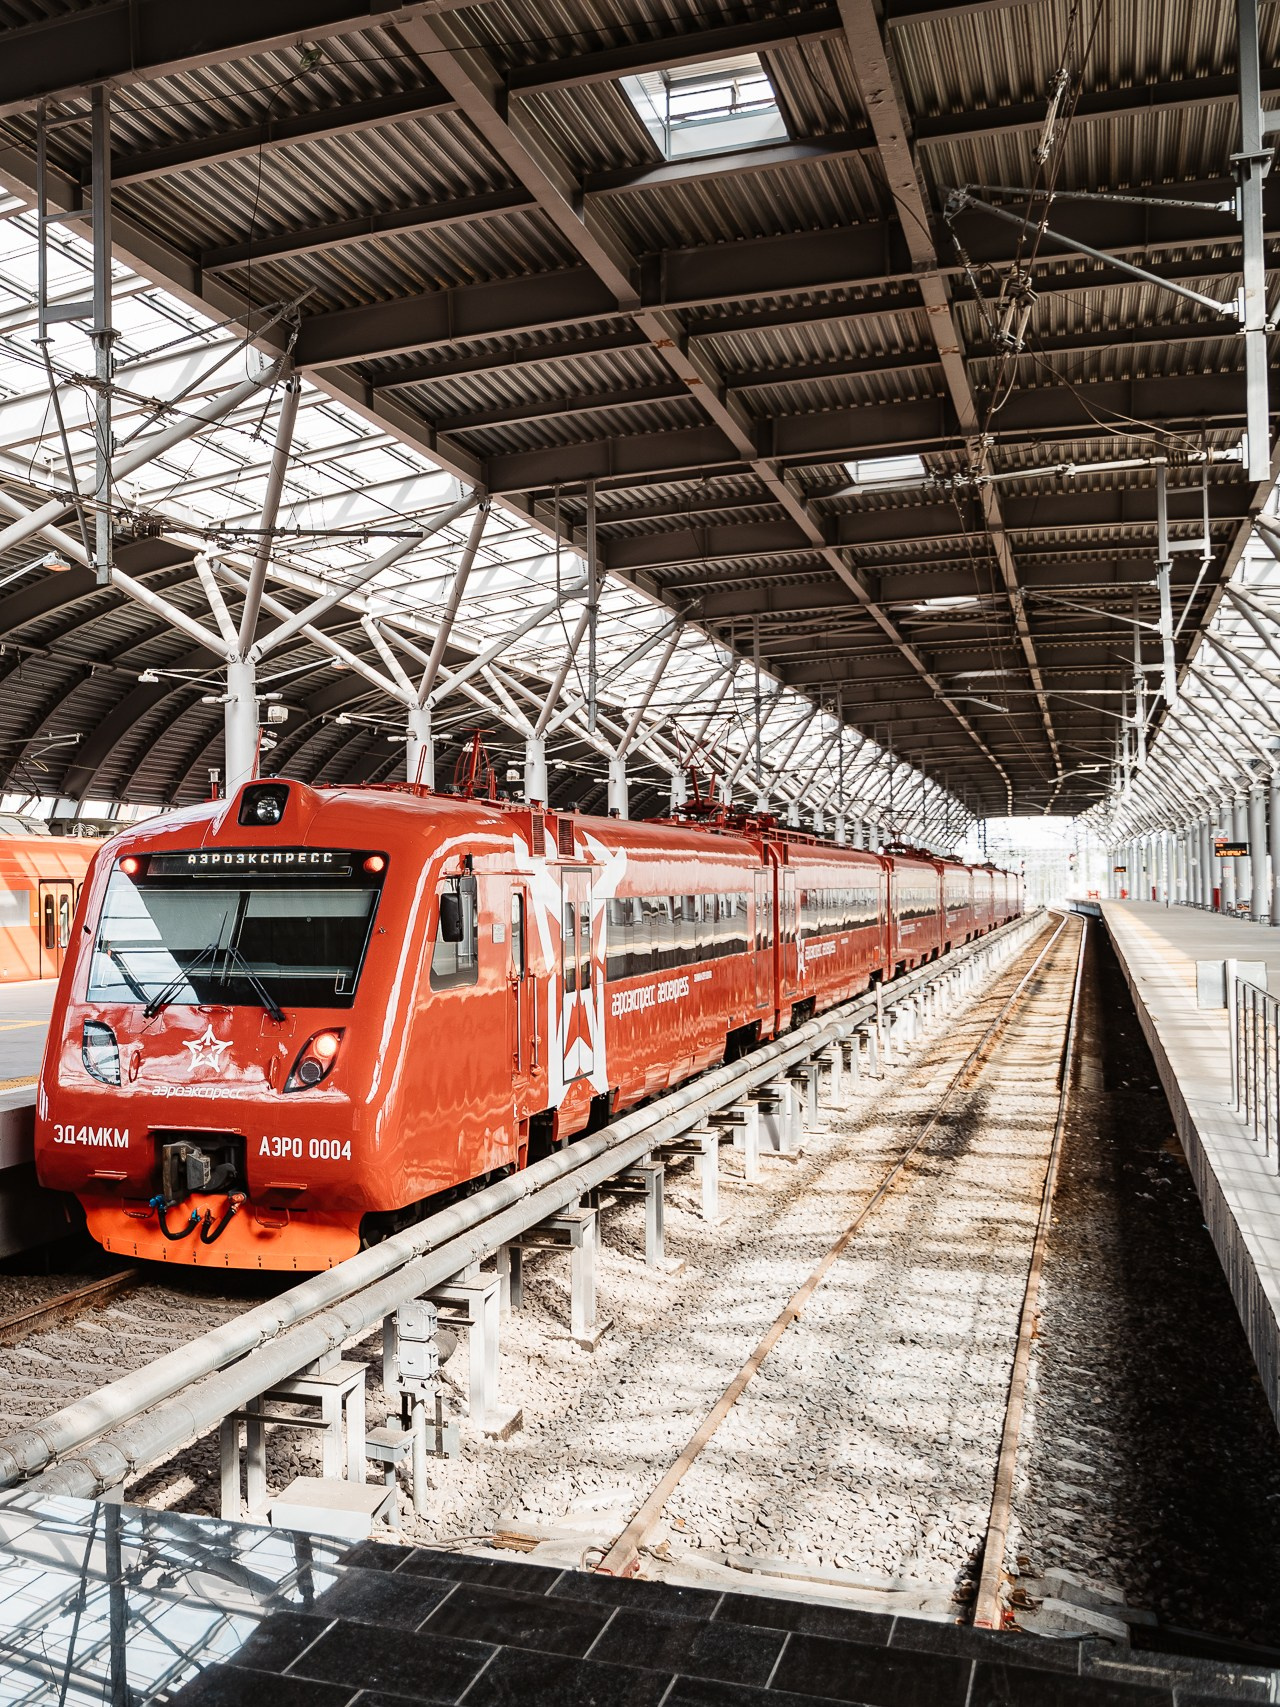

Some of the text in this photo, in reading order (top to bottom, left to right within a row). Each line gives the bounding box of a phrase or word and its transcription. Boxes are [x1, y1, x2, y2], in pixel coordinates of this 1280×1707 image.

[188, 853, 332, 864] АЭРОЭКСПРЕСС
[612, 976, 689, 1020] аэроэкспресс aeroexpress
[152, 1086, 244, 1100] аэроэкспресс
[53, 1124, 129, 1148] ЭД4МКМ
[259, 1136, 352, 1161] АЭРО 0004
